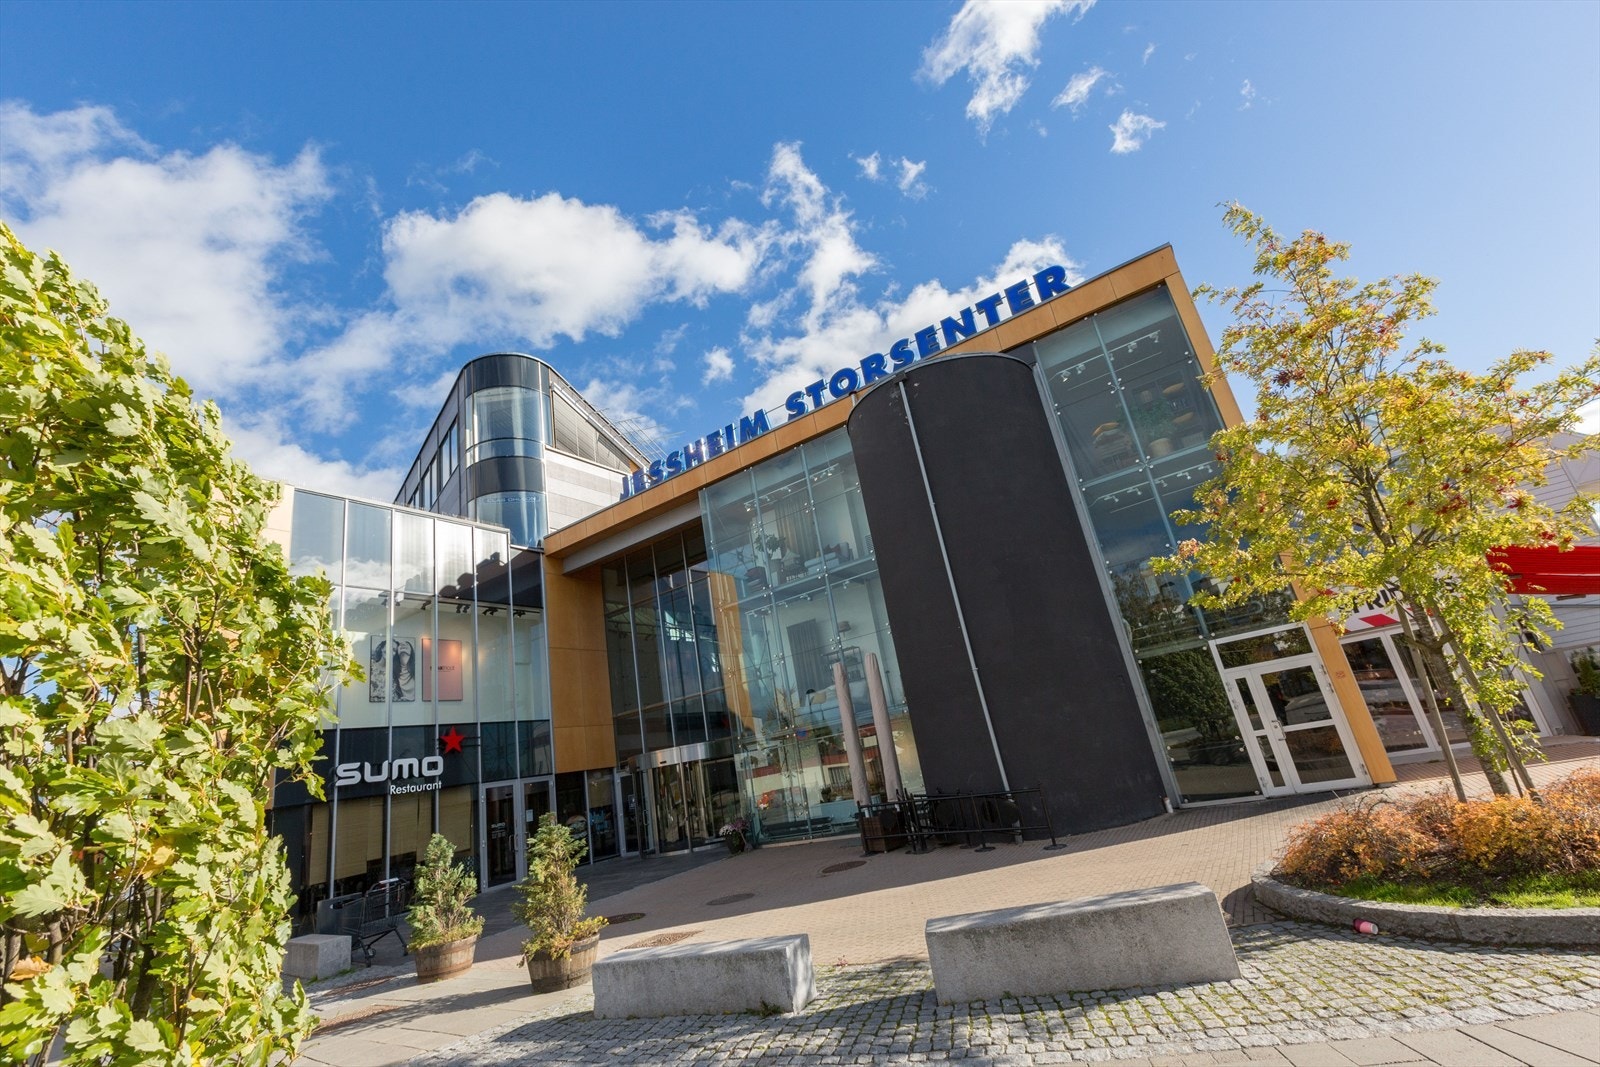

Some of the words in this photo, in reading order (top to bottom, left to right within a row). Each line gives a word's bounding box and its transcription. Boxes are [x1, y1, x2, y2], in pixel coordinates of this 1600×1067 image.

[620, 408, 771, 501] JESSHEIM
[785, 265, 1072, 421] STORSENTER
[390, 780, 442, 795] Restaurant
